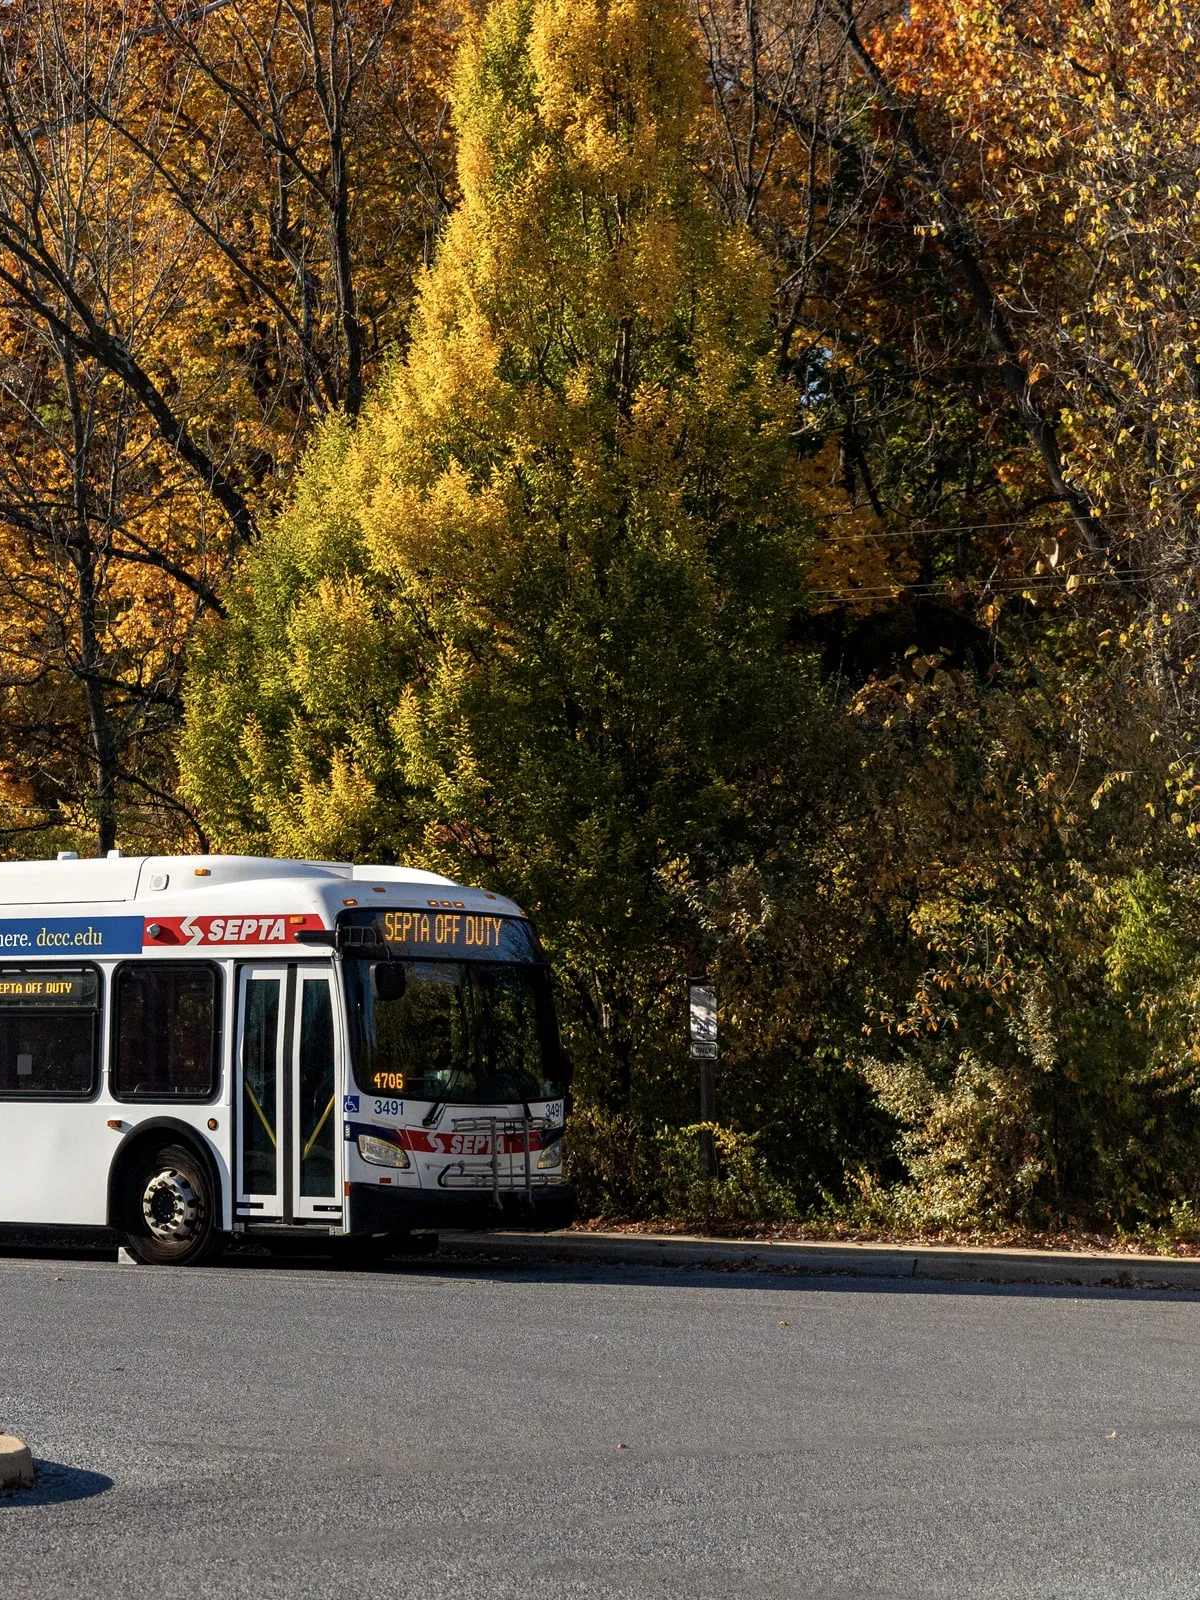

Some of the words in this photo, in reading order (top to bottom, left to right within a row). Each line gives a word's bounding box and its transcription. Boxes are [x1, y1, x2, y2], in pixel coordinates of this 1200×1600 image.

[36, 926, 103, 947] dccc.edu
[207, 919, 286, 941] SEPTA
[385, 912, 429, 942] SEPTA
[435, 914, 461, 944] OFF
[465, 915, 502, 946] DUTY
[25, 983, 43, 994] OFF
[46, 982, 73, 994] DUTY
[374, 1072, 404, 1089] 4706
[374, 1100, 404, 1116] 3491
[545, 1103, 562, 1118] 3491
[450, 1135, 505, 1155] SEPTA
